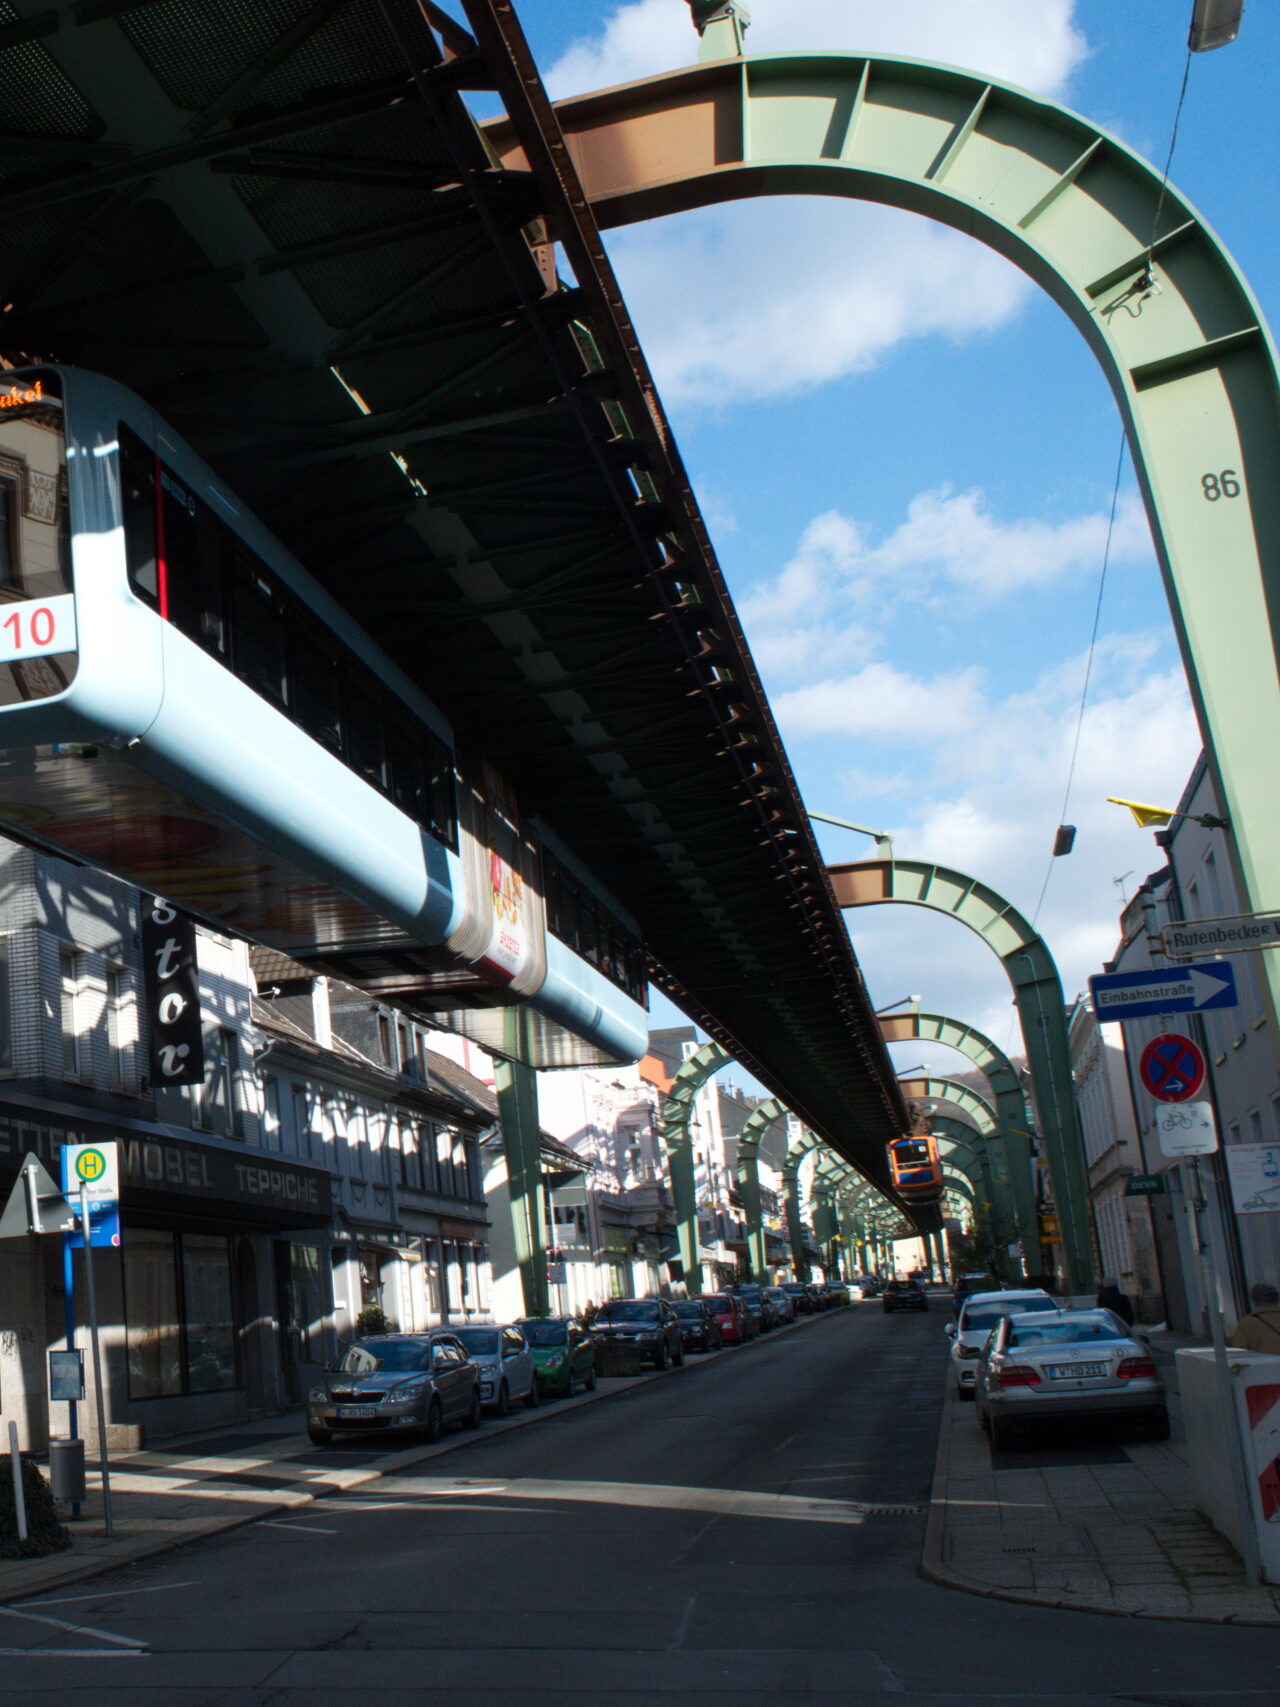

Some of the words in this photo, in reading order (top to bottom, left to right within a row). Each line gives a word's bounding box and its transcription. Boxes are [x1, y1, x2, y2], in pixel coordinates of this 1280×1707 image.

[1200, 469, 1241, 502] 86
[3, 607, 56, 649] 10
[1173, 924, 1270, 948] Rutenbecker
[1100, 984, 1195, 1005] Einbahnstraße
[84, 1155, 97, 1175] H
[114, 1135, 217, 1187] MÖBEL
[234, 1163, 321, 1202] TEPPICHE
